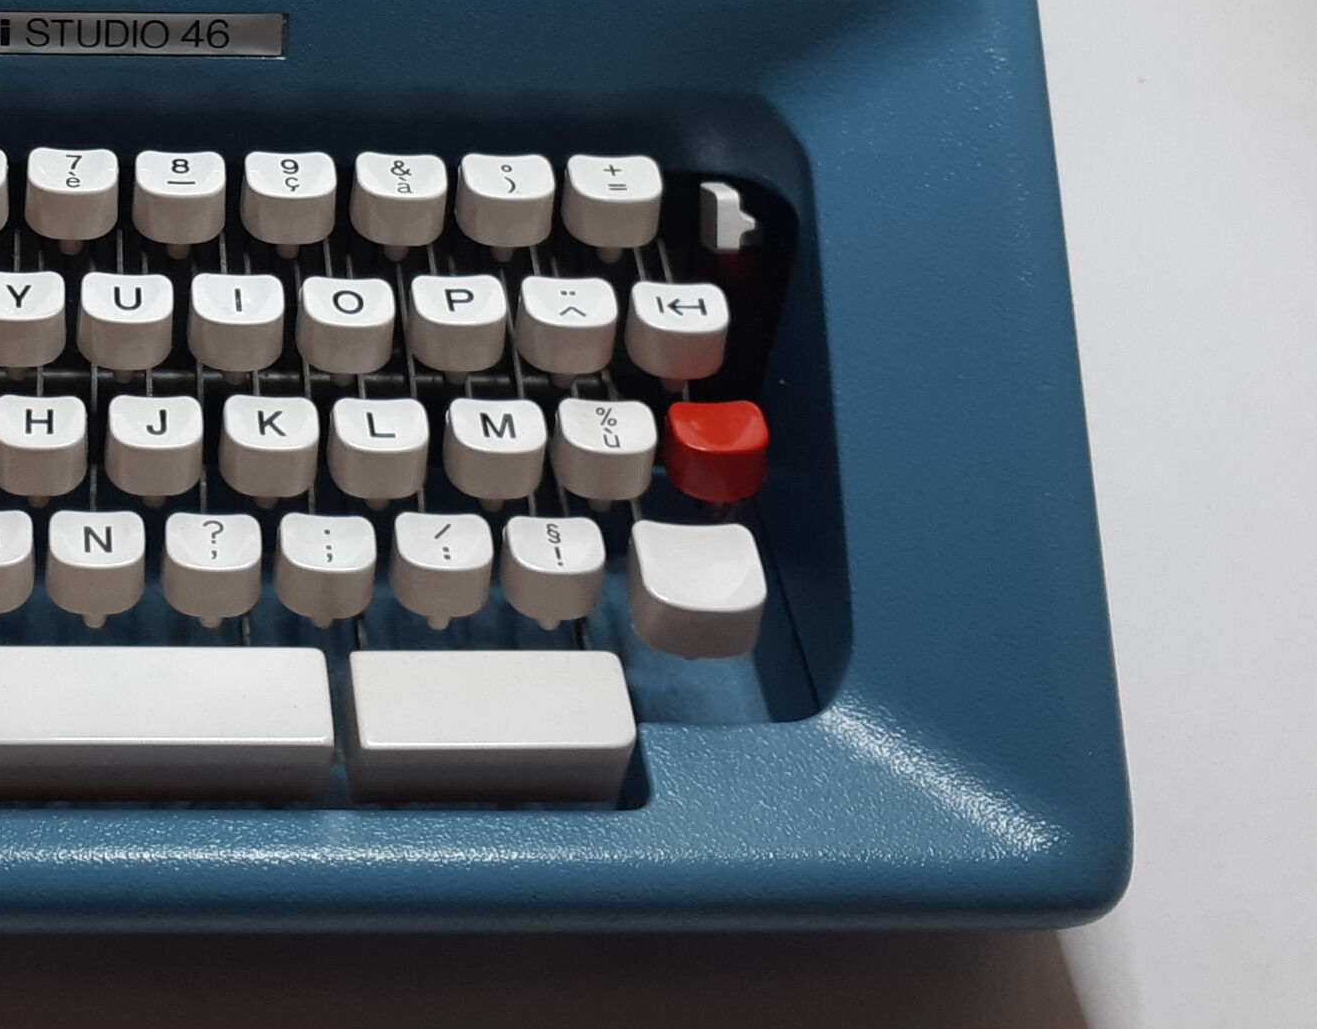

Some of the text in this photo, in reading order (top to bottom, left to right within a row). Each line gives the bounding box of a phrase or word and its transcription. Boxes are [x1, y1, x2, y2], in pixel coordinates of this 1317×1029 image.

[25, 18, 170, 49] STUDIO
[180, 19, 230, 49] 46
[65, 153, 83, 171] 7
[170, 157, 191, 175] 8
[279, 158, 300, 176] 9
[389, 159, 413, 178] &
[602, 163, 623, 177] +
[65, 170, 82, 189] è
[284, 176, 301, 193] ç
[503, 176, 516, 193] )
[5, 283, 33, 309] Y
[113, 285, 143, 312] U
[233, 287, 243, 313] I
[331, 289, 365, 316] O
[443, 287, 475, 313] P
[24, 407, 55, 436] H
[145, 408, 168, 437] J
[256, 409, 288, 438] K
[365, 411, 397, 439] L
[478, 411, 518, 440] M
[594, 406, 618, 427] %
[602, 426, 622, 449] ù
[82, 525, 114, 554] N
[201, 519, 225, 545] ?
[433, 523, 452, 541] /
[545, 522, 562, 545] §
[325, 544, 334, 564] ;
[441, 546, 452, 561] :
[553, 545, 564, 567] !
